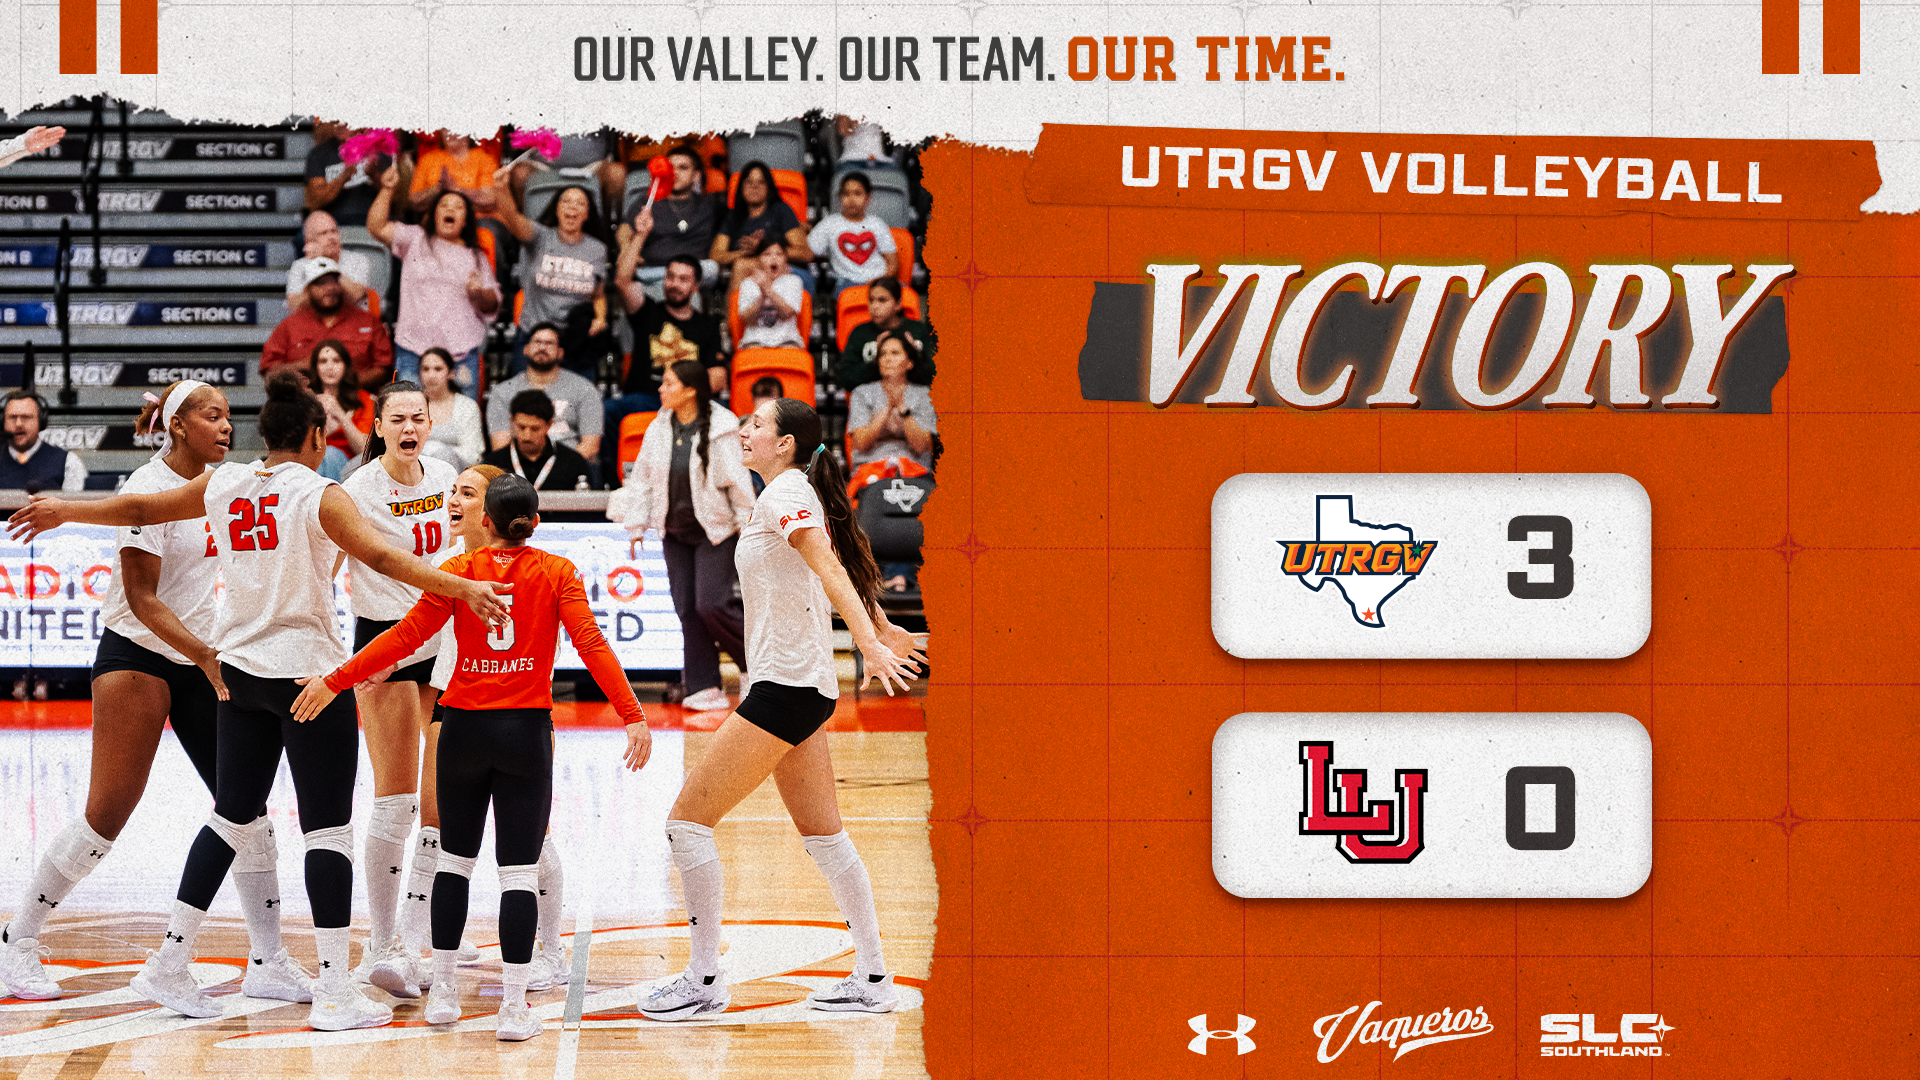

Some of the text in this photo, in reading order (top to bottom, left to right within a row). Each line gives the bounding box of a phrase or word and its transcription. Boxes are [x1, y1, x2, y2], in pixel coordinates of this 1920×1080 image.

[196, 143, 277, 157] SECTION C
[185, 195, 268, 210] SECTION C
[173, 249, 258, 265] SECTION C
[161, 307, 248, 323] SECTION C
[147, 367, 237, 383] SECTION C
[386, 491, 444, 517] UTRGV
[228, 493, 279, 551] 25
[779, 510, 812, 530] SLC
[412, 520, 442, 556] 10
[461, 657, 534, 673] CABRANES
